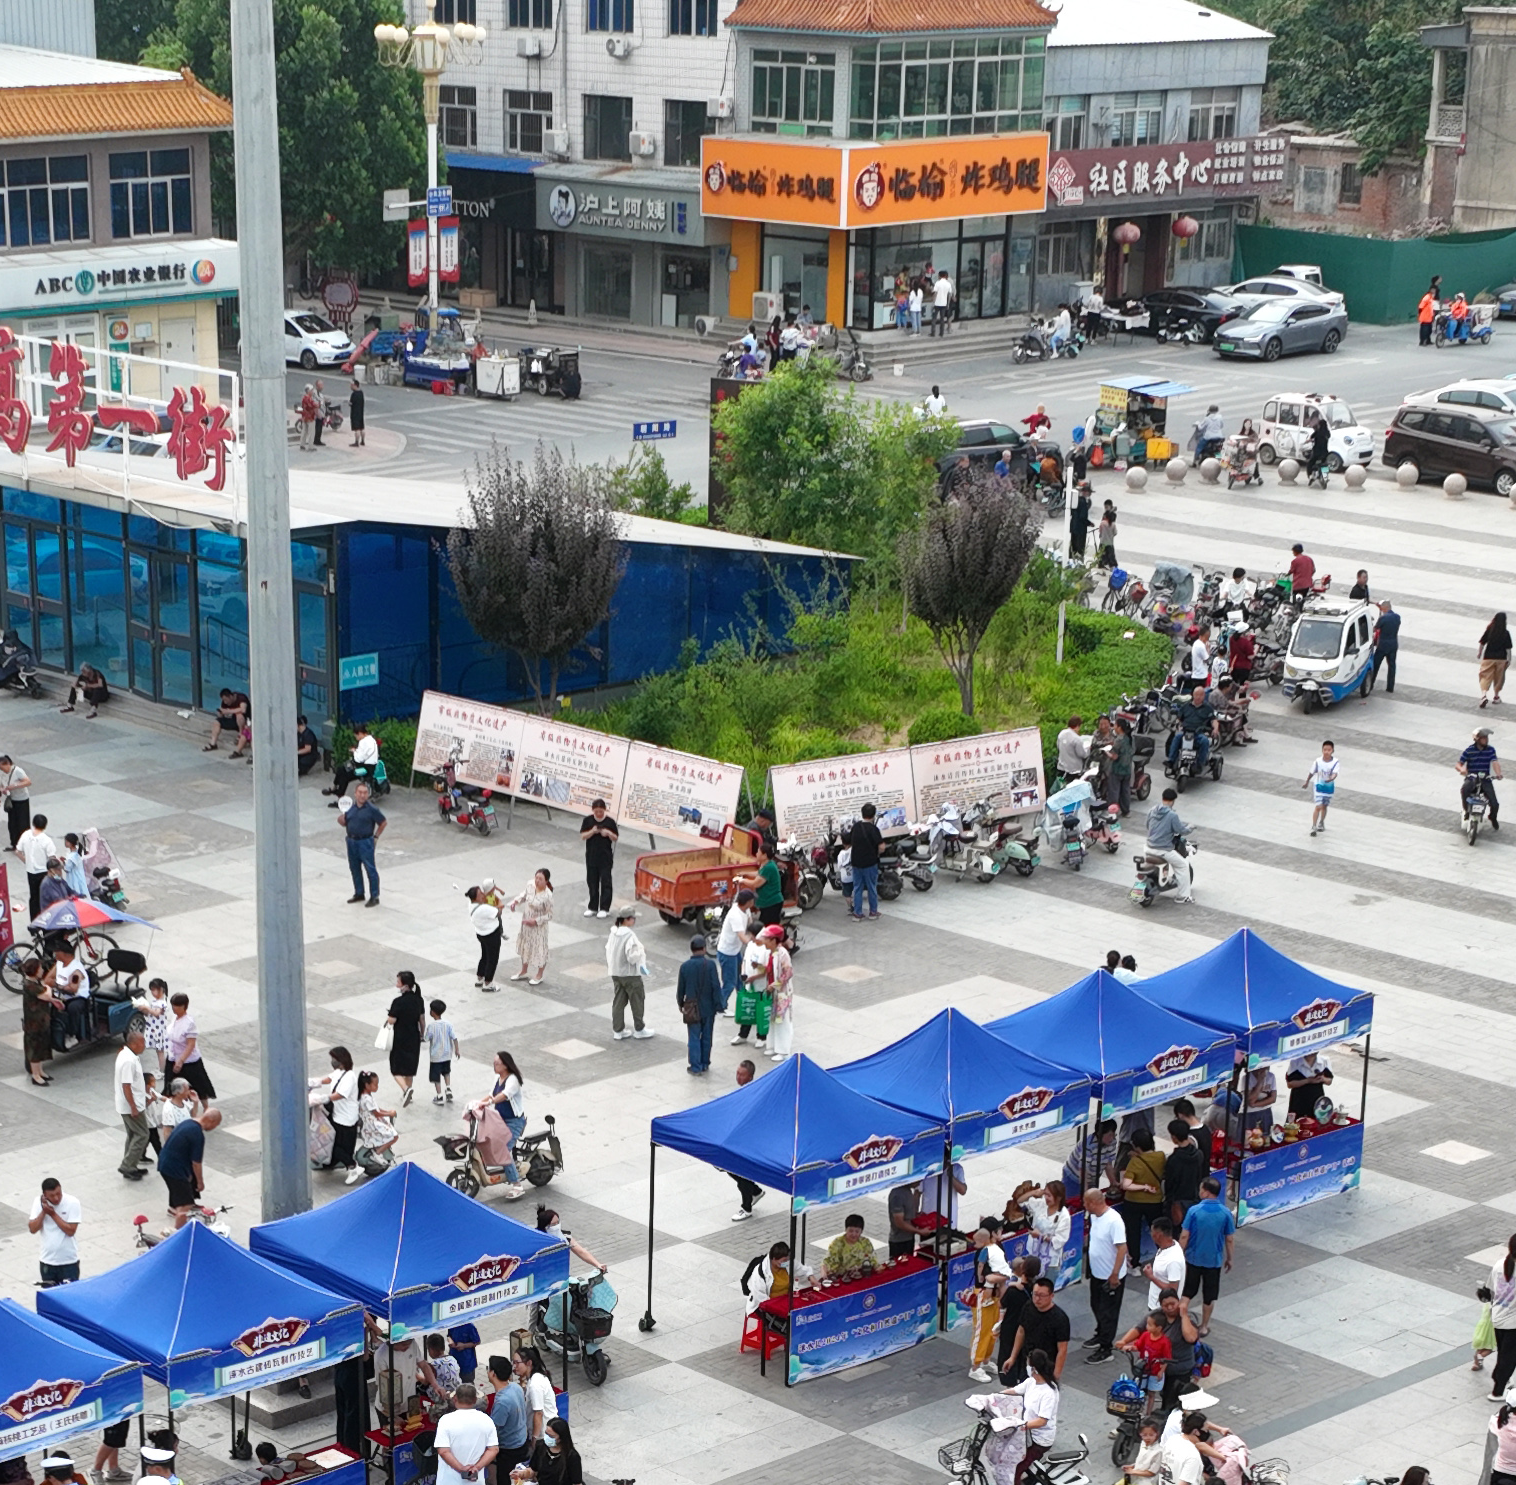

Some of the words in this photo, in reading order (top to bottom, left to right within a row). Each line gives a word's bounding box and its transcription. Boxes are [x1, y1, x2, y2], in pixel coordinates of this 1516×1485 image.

[776, 172, 836, 204] 炸鸡腿
[961, 156, 1041, 196] 炸鸡腿
[1088, 151, 1212, 198] 社区服务中心
[578, 192, 666, 220] 沪上阿姨
[35, 276, 73, 296] ABC
[97, 262, 187, 289] 中国农业银行
[21, 1389, 63, 1414] 非遗文化
